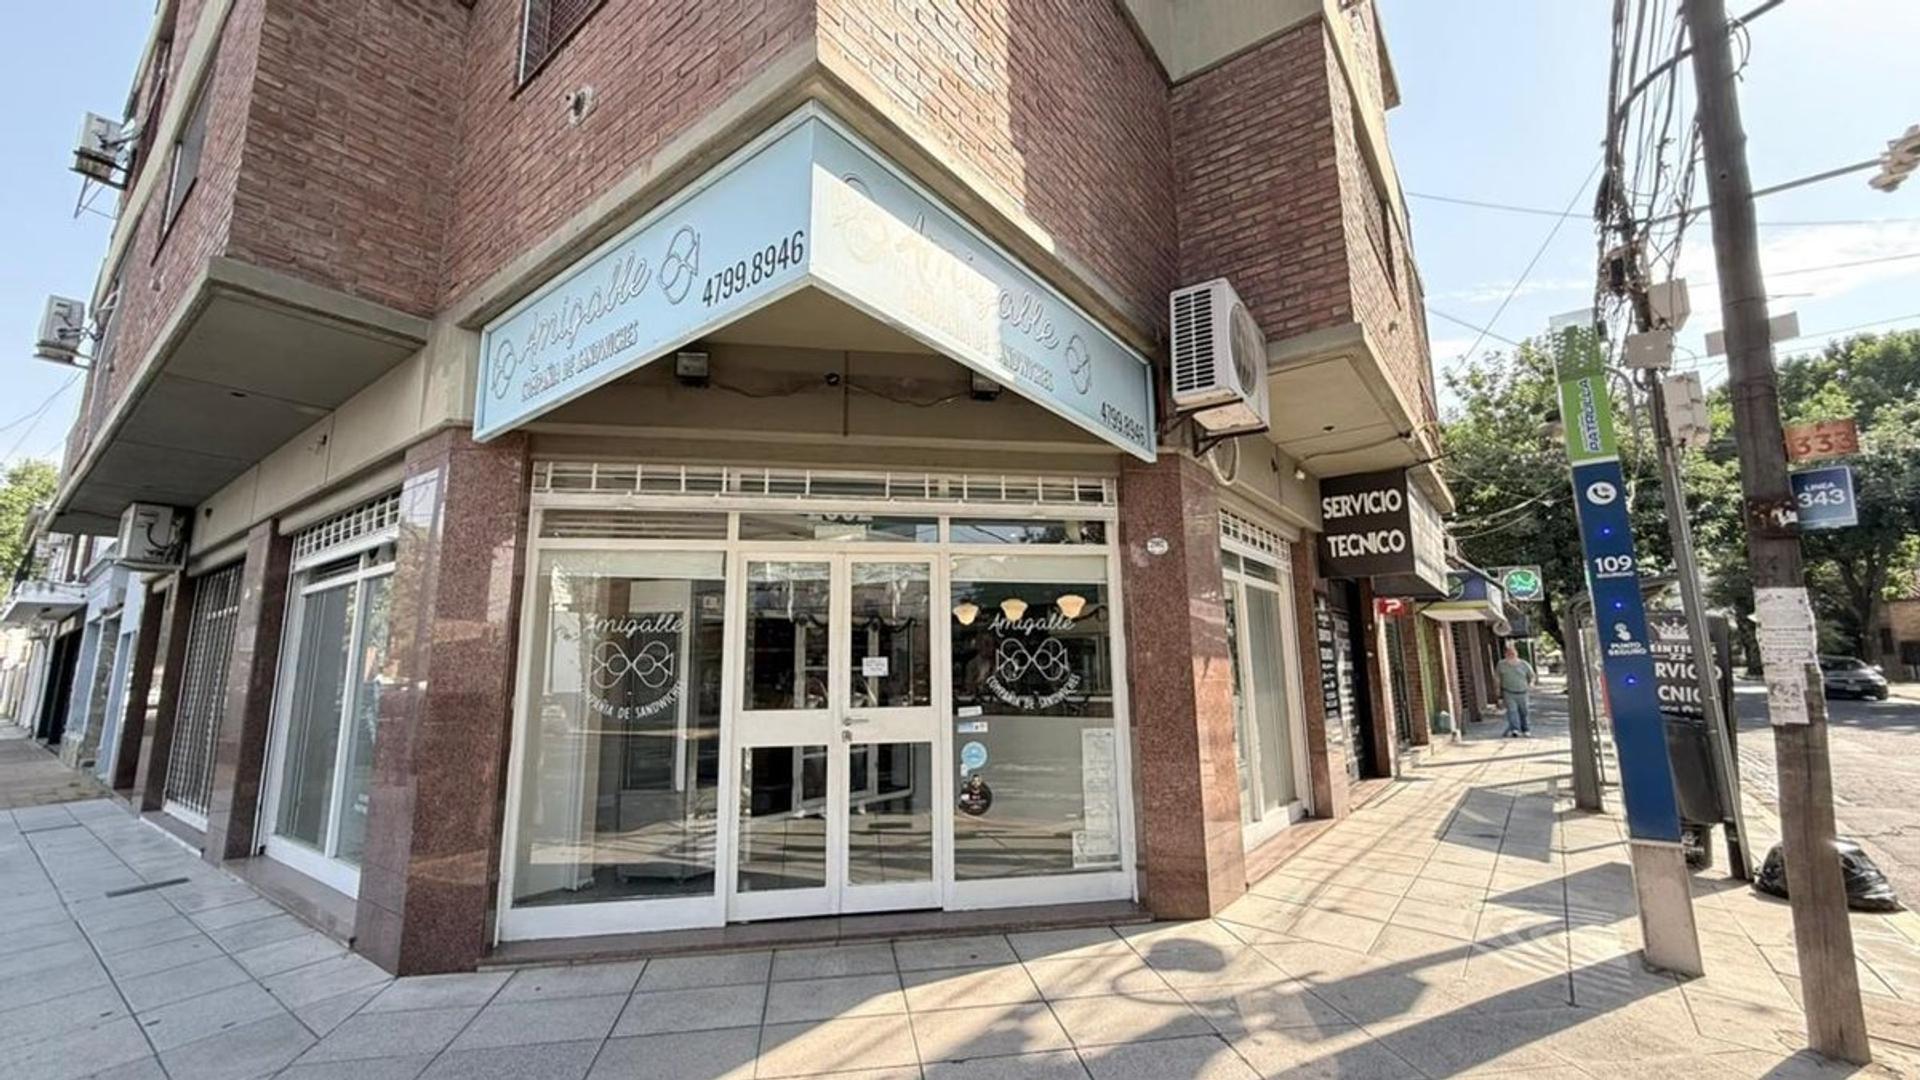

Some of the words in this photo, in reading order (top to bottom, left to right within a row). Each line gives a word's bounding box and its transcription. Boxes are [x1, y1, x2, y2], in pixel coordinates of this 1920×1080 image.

[703, 230, 804, 307] 4799.8946
[518, 250, 652, 373] Amigalle
[1793, 431, 1853, 455] 333
[1322, 489, 1402, 519] SERVICIO
[1797, 489, 1845, 508] 343
[1326, 529, 1406, 558] TECNICO
[1595, 555, 1632, 572] 109
[987, 612, 1076, 638] Amigalle
[1658, 685, 1702, 703] CNIC
[618, 706, 630, 719] DE
